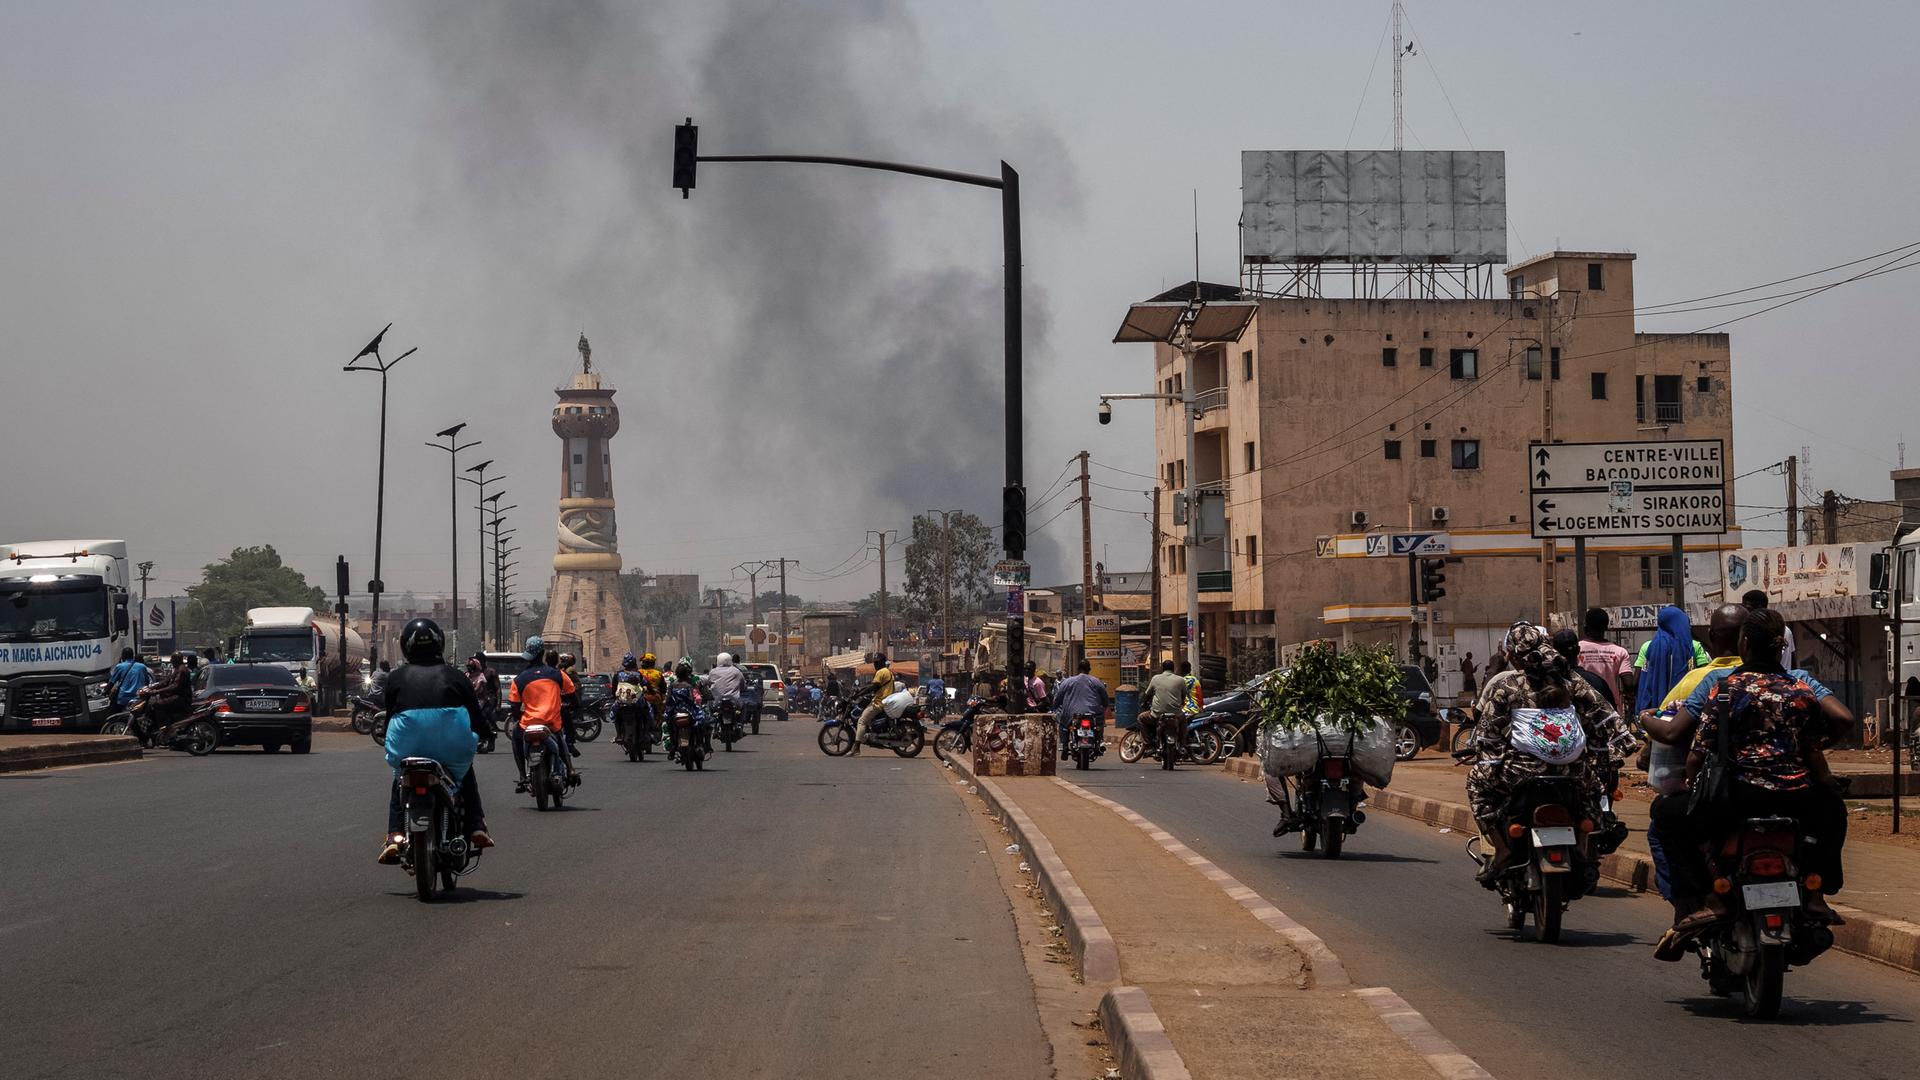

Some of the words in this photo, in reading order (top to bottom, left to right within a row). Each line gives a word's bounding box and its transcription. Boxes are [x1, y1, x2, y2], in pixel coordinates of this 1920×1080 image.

[1604, 447, 1719, 463] CENTRE-VILLE
[1586, 465, 1720, 481] BACODJICORONI
[1643, 495, 1722, 510] SIRAKORO
[1557, 515, 1651, 530] LOGEMENTS
[1655, 513, 1722, 528] SOCIAUX
[1096, 618, 1114, 626] BMS
[1621, 620, 1639, 628] AUTO
[1643, 618, 1657, 627] PAR
[12, 646, 42, 663] MAIGA
[44, 644, 91, 661] AICHATOU
[92, 644, 103, 655] 4
